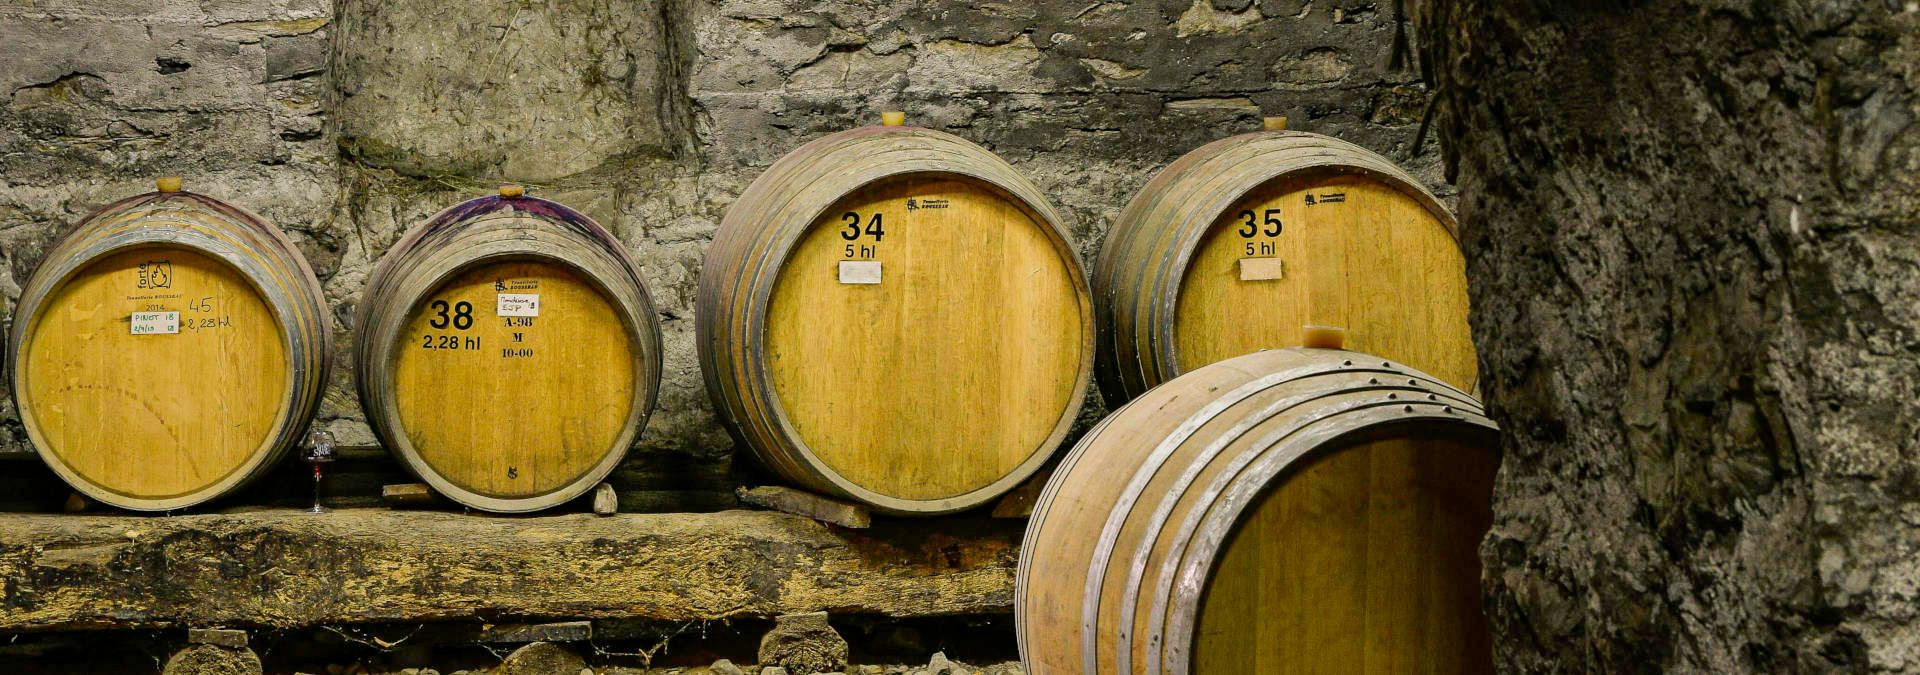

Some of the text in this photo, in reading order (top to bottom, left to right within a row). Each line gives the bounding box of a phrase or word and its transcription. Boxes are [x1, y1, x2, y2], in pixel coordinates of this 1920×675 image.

[841, 211, 884, 241] 34
[1238, 208, 1282, 238] 35
[845, 244, 876, 259] 5 hl
[1246, 241, 1275, 256] 5 hl
[145, 304, 166, 312] 2014
[189, 296, 214, 313] 45
[135, 314, 160, 322] PINOT
[429, 300, 473, 330] 38
[504, 317, 533, 328] A-98
[422, 335, 480, 351] 2,28 hl
[513, 332, 523, 342] M
[502, 348, 533, 358] 10-00
